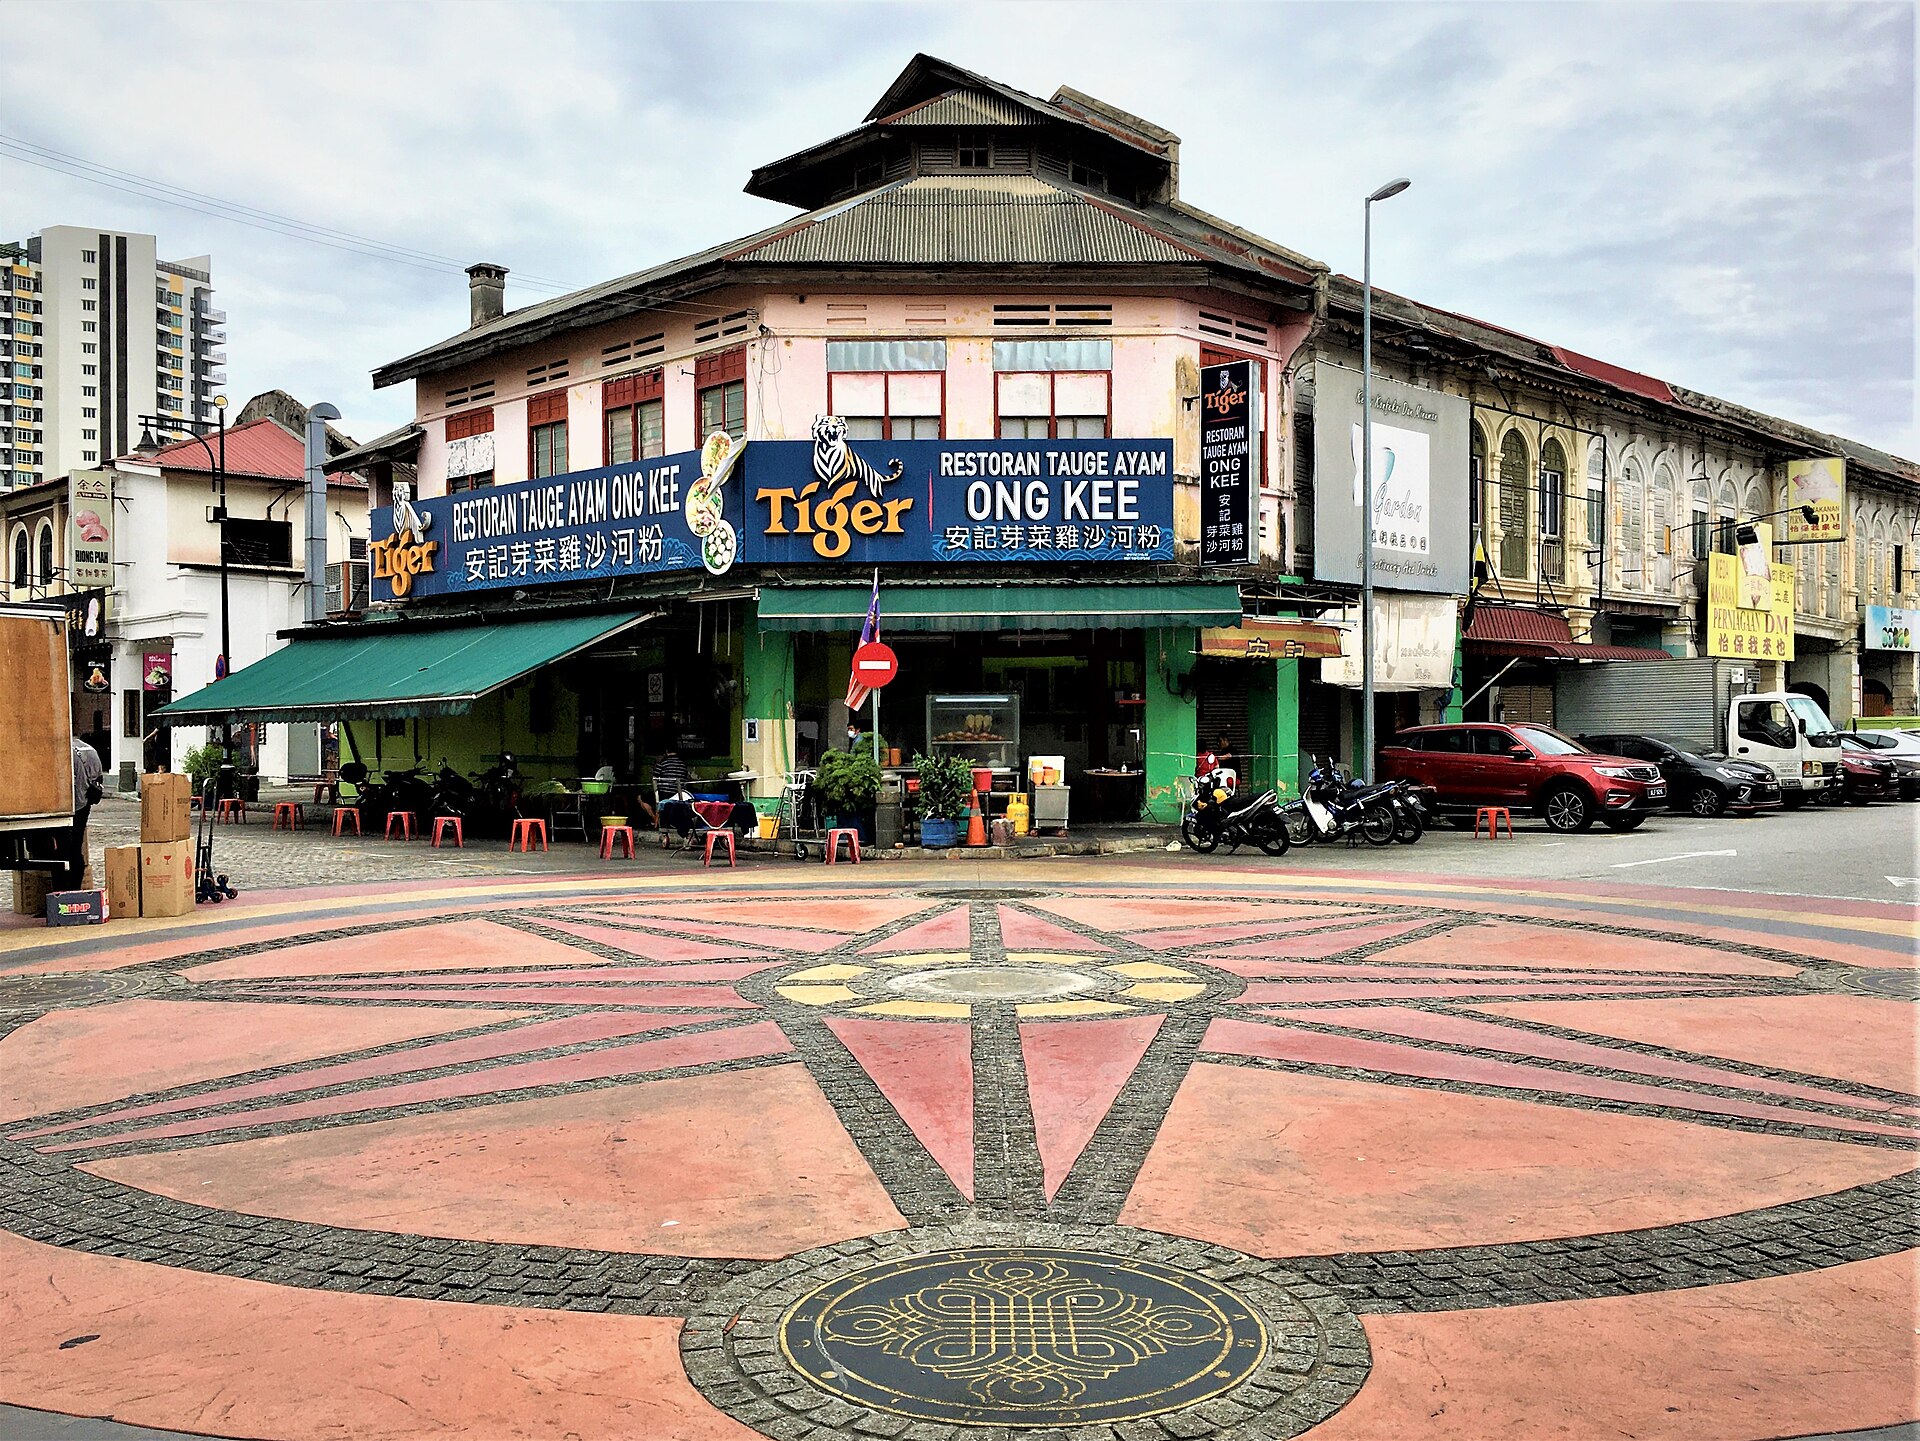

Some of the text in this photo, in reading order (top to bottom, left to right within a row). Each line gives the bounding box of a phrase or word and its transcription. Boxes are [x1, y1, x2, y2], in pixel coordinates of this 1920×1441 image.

[1204, 388, 1248, 415] Tiger
[1206, 426, 1245, 444] RESTORAN
[1203, 441, 1249, 460] TAUGE AYAM
[940, 451, 1167, 477] RESTORAN TAUGE AYAM
[1209, 457, 1241, 474] ONG
[1210, 473, 1240, 489] KEE
[453, 464, 681, 543] RESTORAN TAUGE AYAM ONG KEE
[966, 480, 1140, 521] ONG KEE
[1374, 482, 1423, 524] Garden
[756, 481, 913, 558] Tiger
[1206, 522, 1244, 538] 芽菜雞
[1821, 513, 1840, 523] DM
[945, 524, 1162, 551] 安記芽菜雞沙河粉
[1206, 538, 1244, 554] 沙河粉
[370, 529, 438, 598] Tiger
[465, 524, 664, 583] 安記芽菜雞沙河粉
[1713, 608, 1789, 636] PERNIAGAAN DM
[1718, 632, 1786, 657] 怡保我來也
